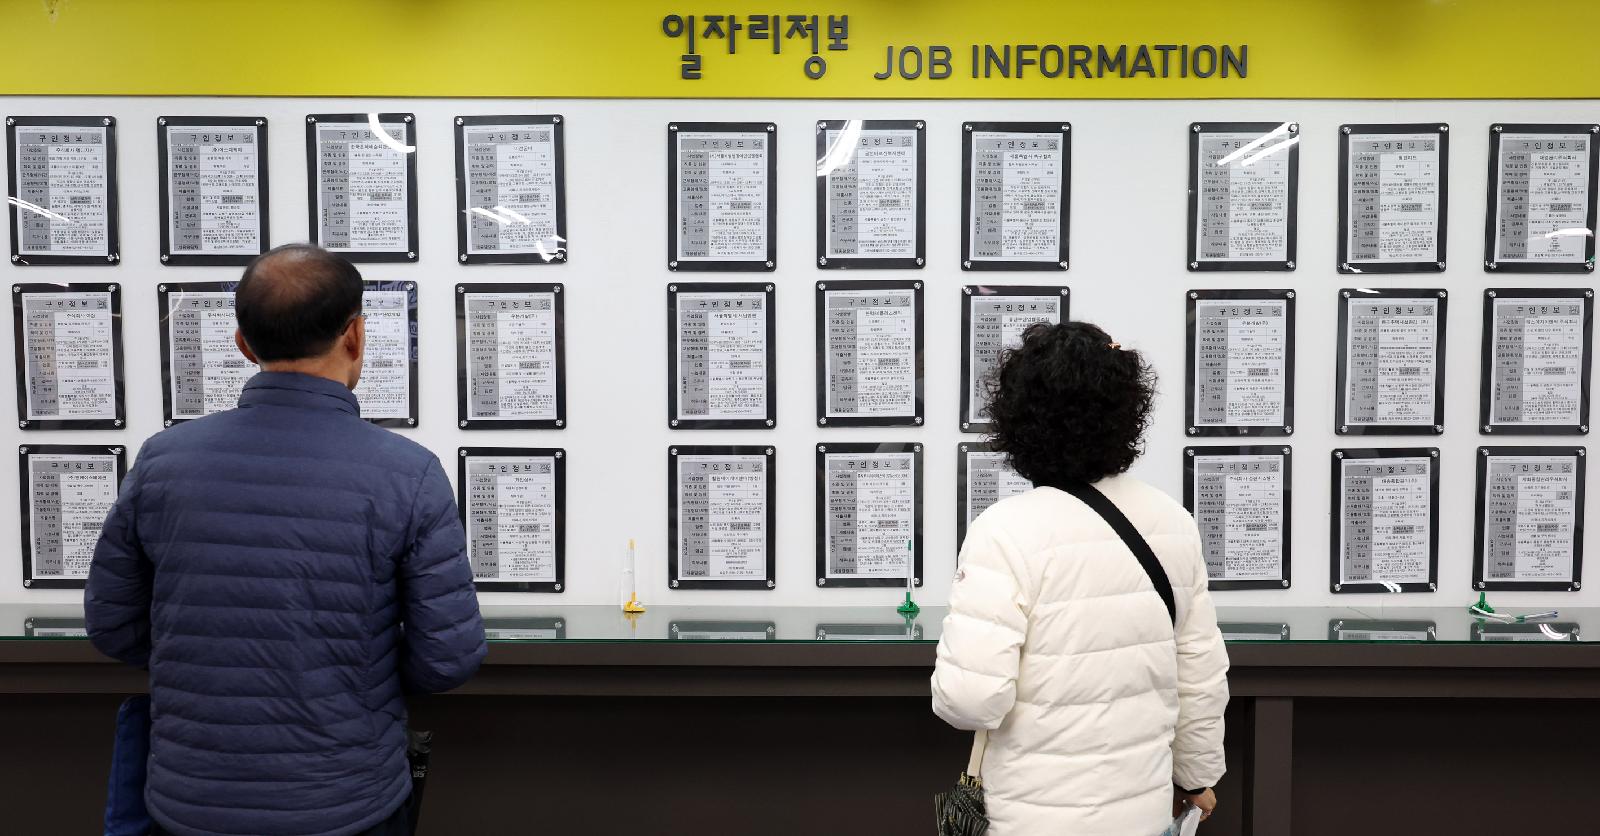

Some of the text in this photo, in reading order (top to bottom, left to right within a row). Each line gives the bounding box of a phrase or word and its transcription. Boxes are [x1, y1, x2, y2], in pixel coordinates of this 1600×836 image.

[662, 14, 849, 80] 일자리정보
[874, 44, 1248, 80] JOB INFORMATION
